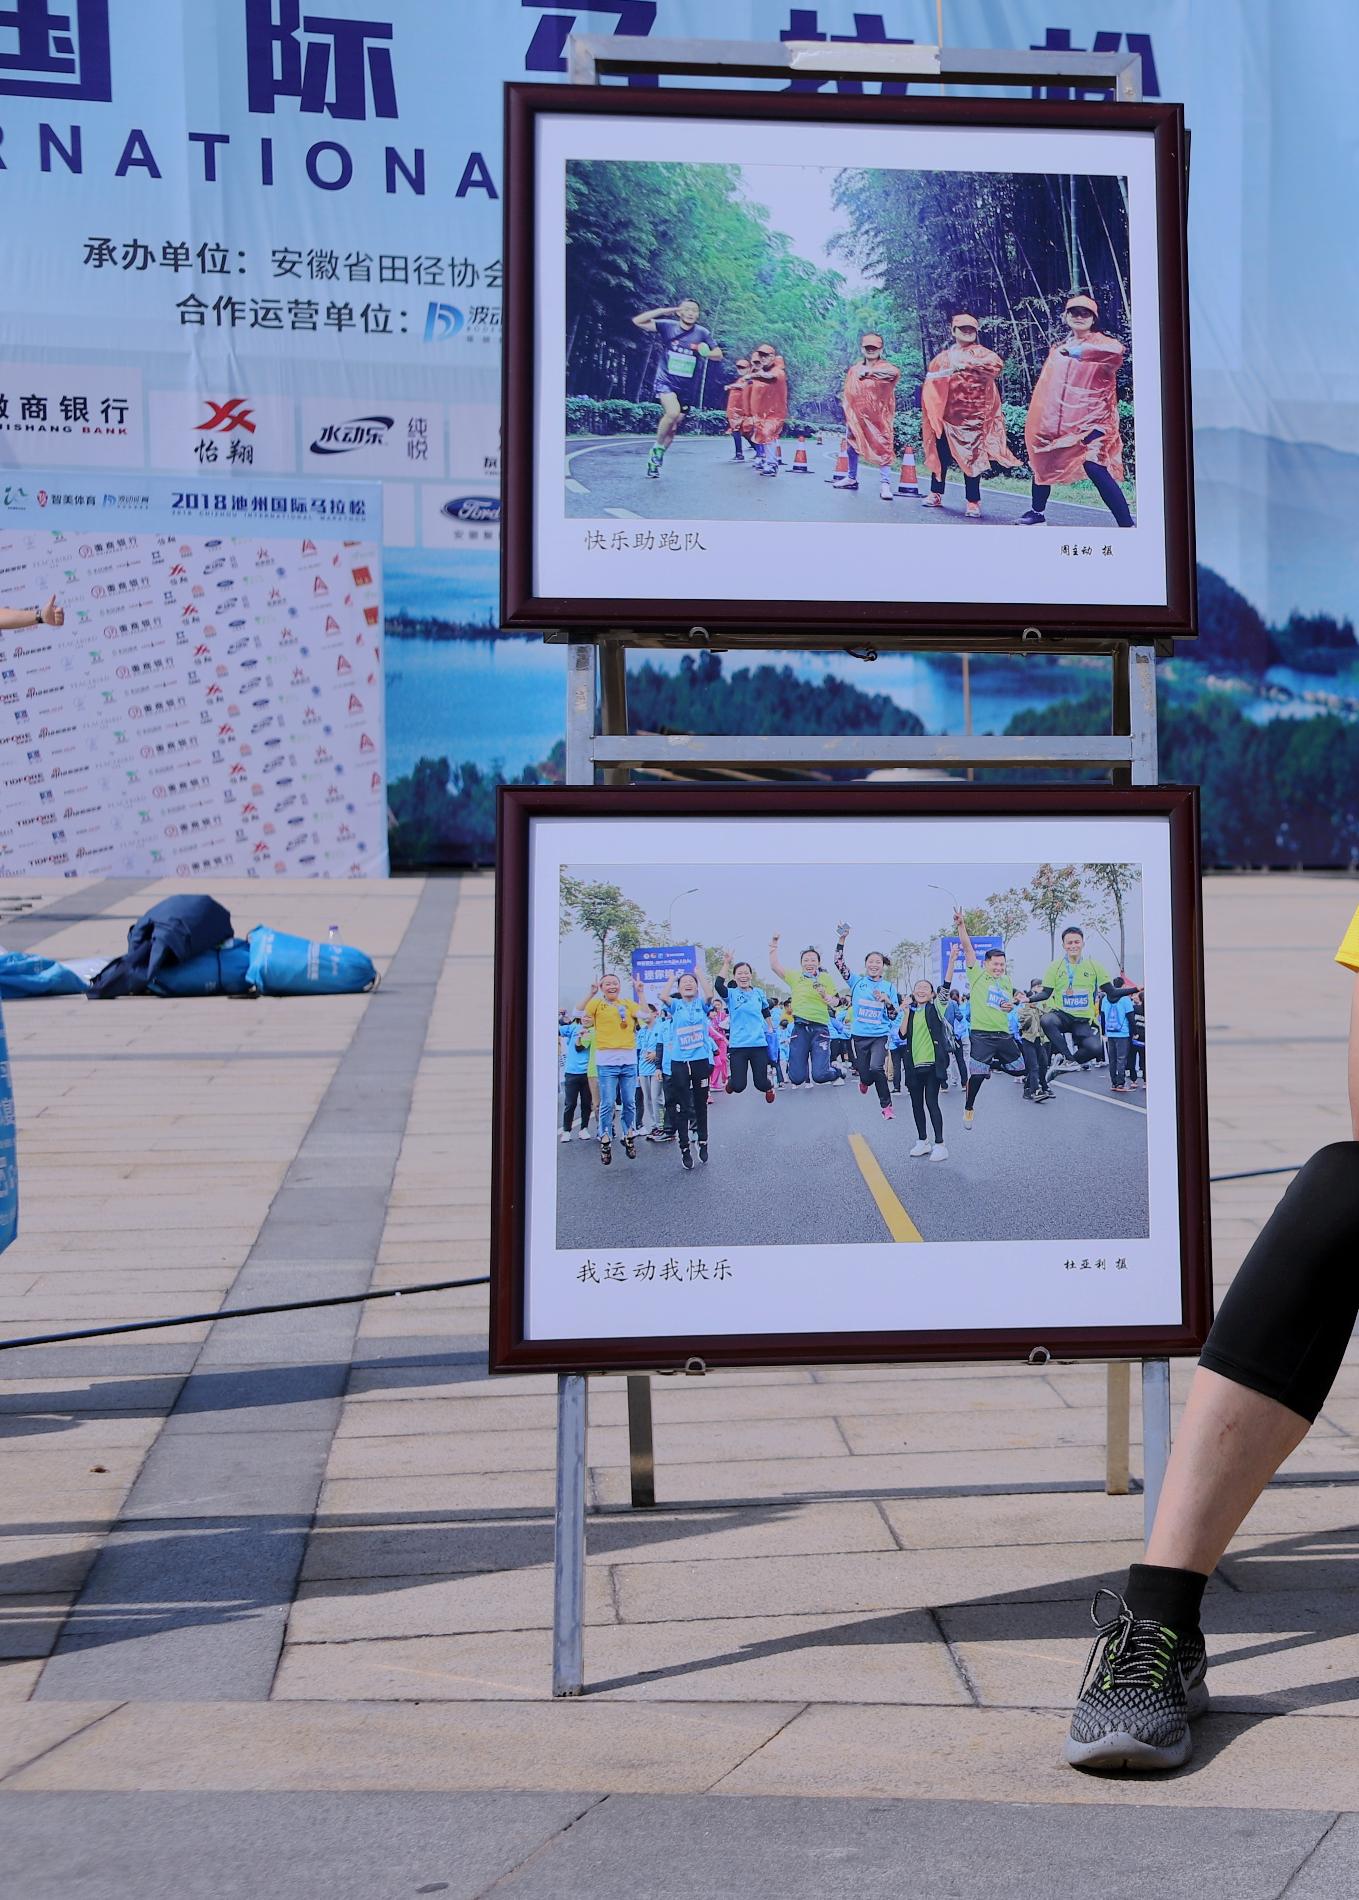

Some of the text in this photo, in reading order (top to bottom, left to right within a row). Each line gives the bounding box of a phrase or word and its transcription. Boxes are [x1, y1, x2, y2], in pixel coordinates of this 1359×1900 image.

[0, 123, 499, 200] NATIONA
[82, 426, 128, 436] BANK
[319, 424, 387, 446] 水动乐
[193, 438, 254, 465] 怡翔
[171, 492, 367, 516] 2018池州国际马拉松
[583, 529, 708, 553] 快乐助跑队
[575, 1258, 734, 1284] 我运动我快乐
